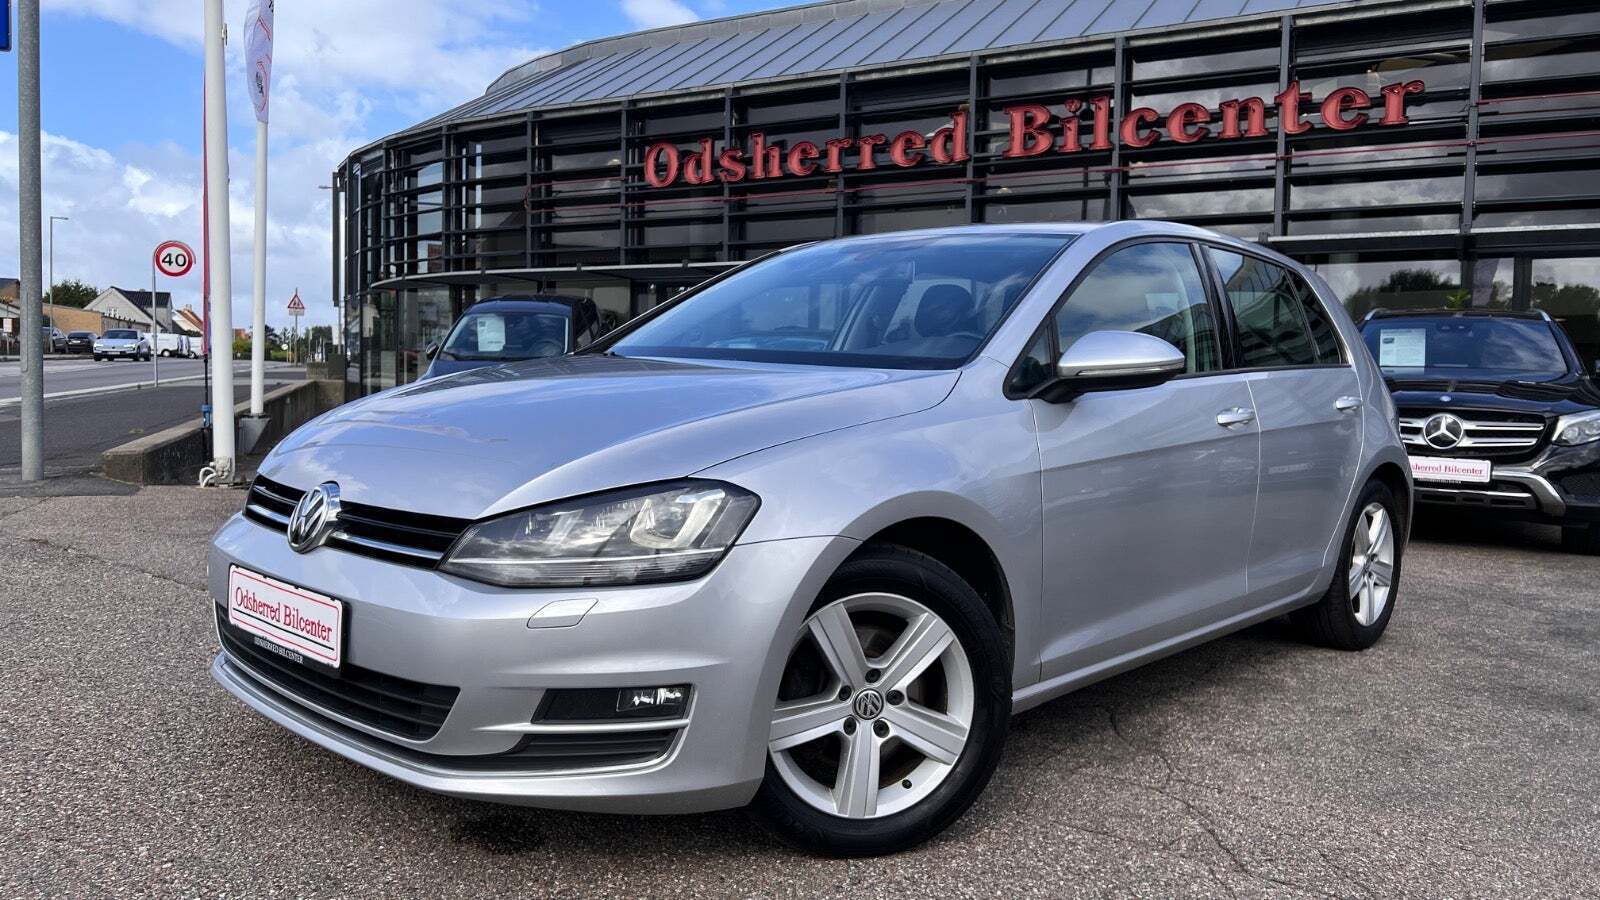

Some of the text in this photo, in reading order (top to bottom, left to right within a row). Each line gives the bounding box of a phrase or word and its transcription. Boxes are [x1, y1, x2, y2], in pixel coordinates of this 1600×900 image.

[643, 79, 1426, 188] Odsherred Bilcenter
[161, 252, 187, 267] 40
[1411, 463, 1442, 472] sherred
[235, 587, 332, 642] Odsherred Bilcenter
